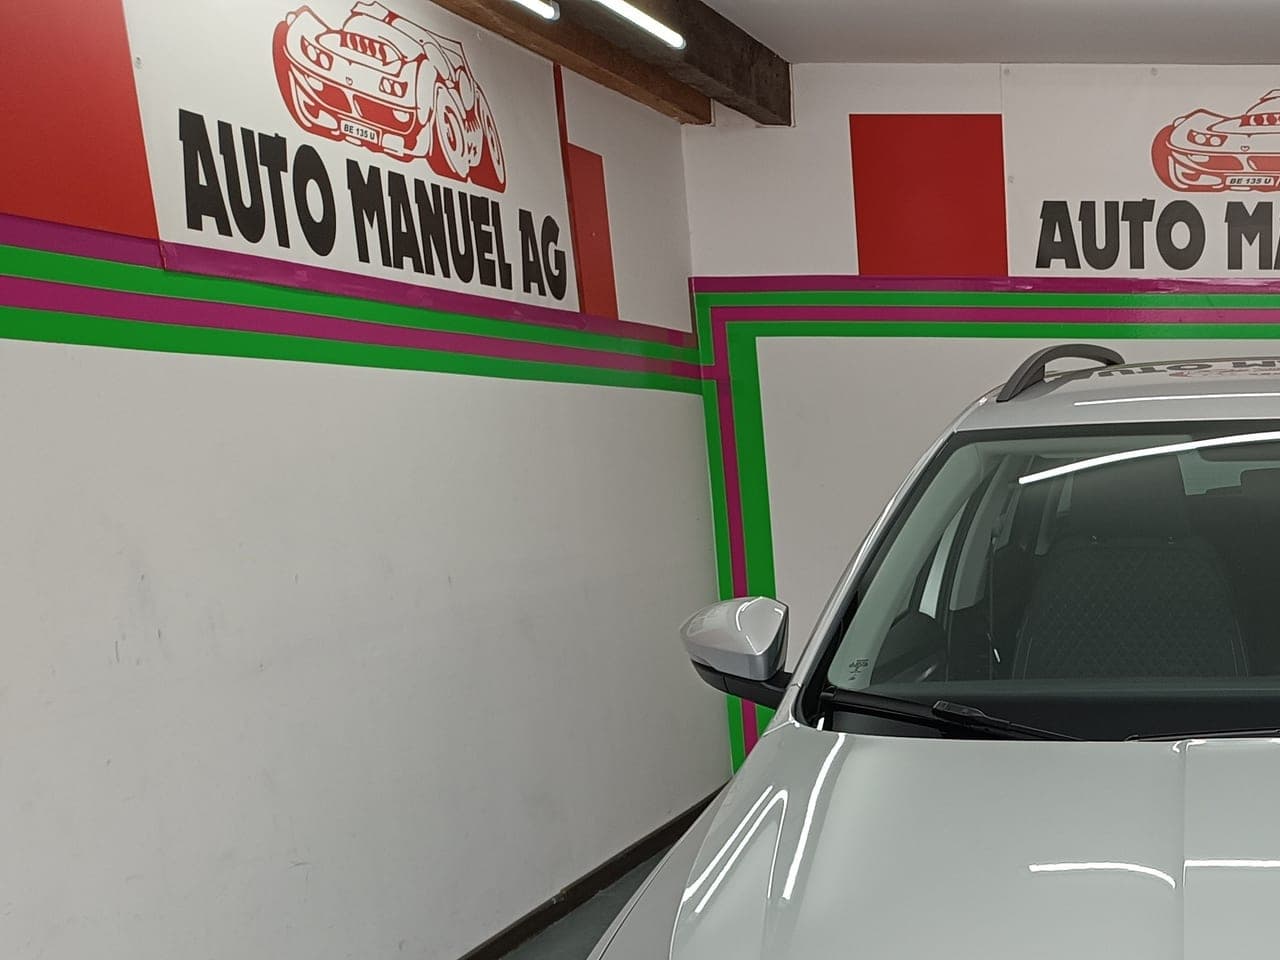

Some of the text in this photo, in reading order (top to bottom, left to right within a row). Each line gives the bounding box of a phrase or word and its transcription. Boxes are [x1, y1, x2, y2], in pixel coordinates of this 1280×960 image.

[178, 108, 567, 300] AUTO MANUEL AG
[1035, 199, 1206, 270] AUTO
